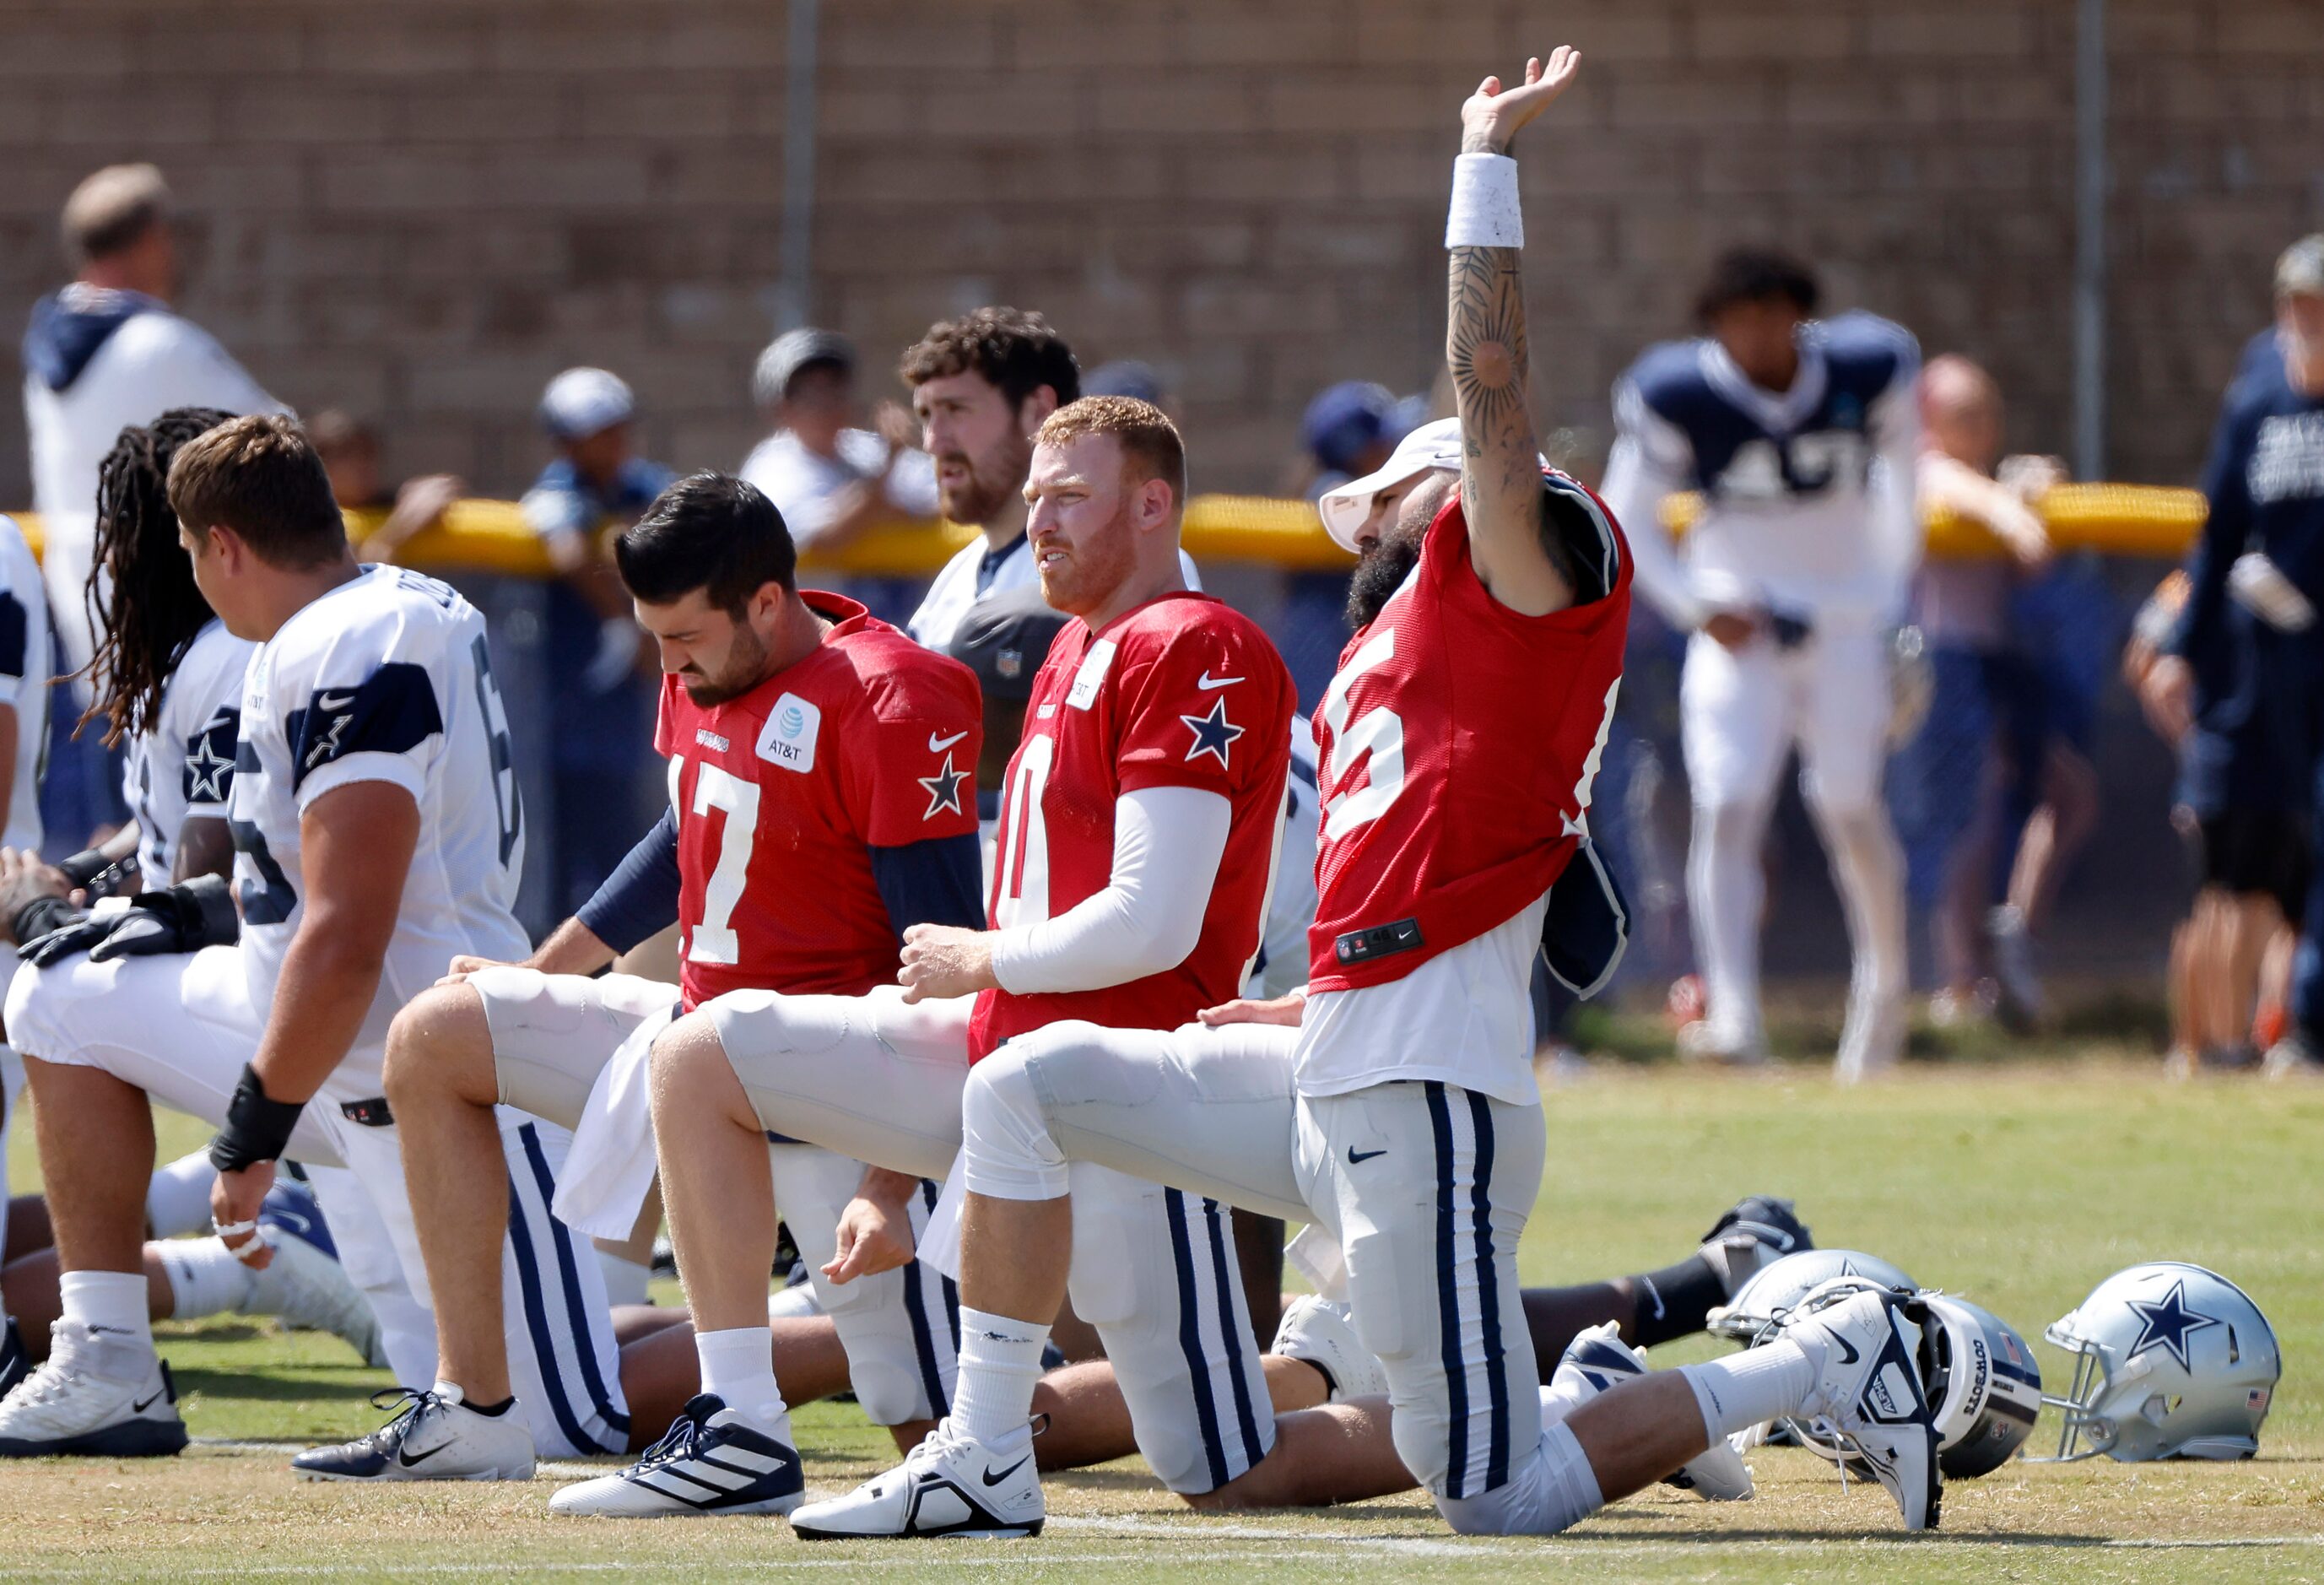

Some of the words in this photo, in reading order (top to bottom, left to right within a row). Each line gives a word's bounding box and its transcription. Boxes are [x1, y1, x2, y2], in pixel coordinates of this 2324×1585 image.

[768, 738, 802, 760] AT&T
[1313, 626, 1405, 847] 5
[995, 733, 1053, 929] 0
[1873, 1374, 1896, 1413] ALPHA
[1963, 1339, 1987, 1416] COWBOYS
